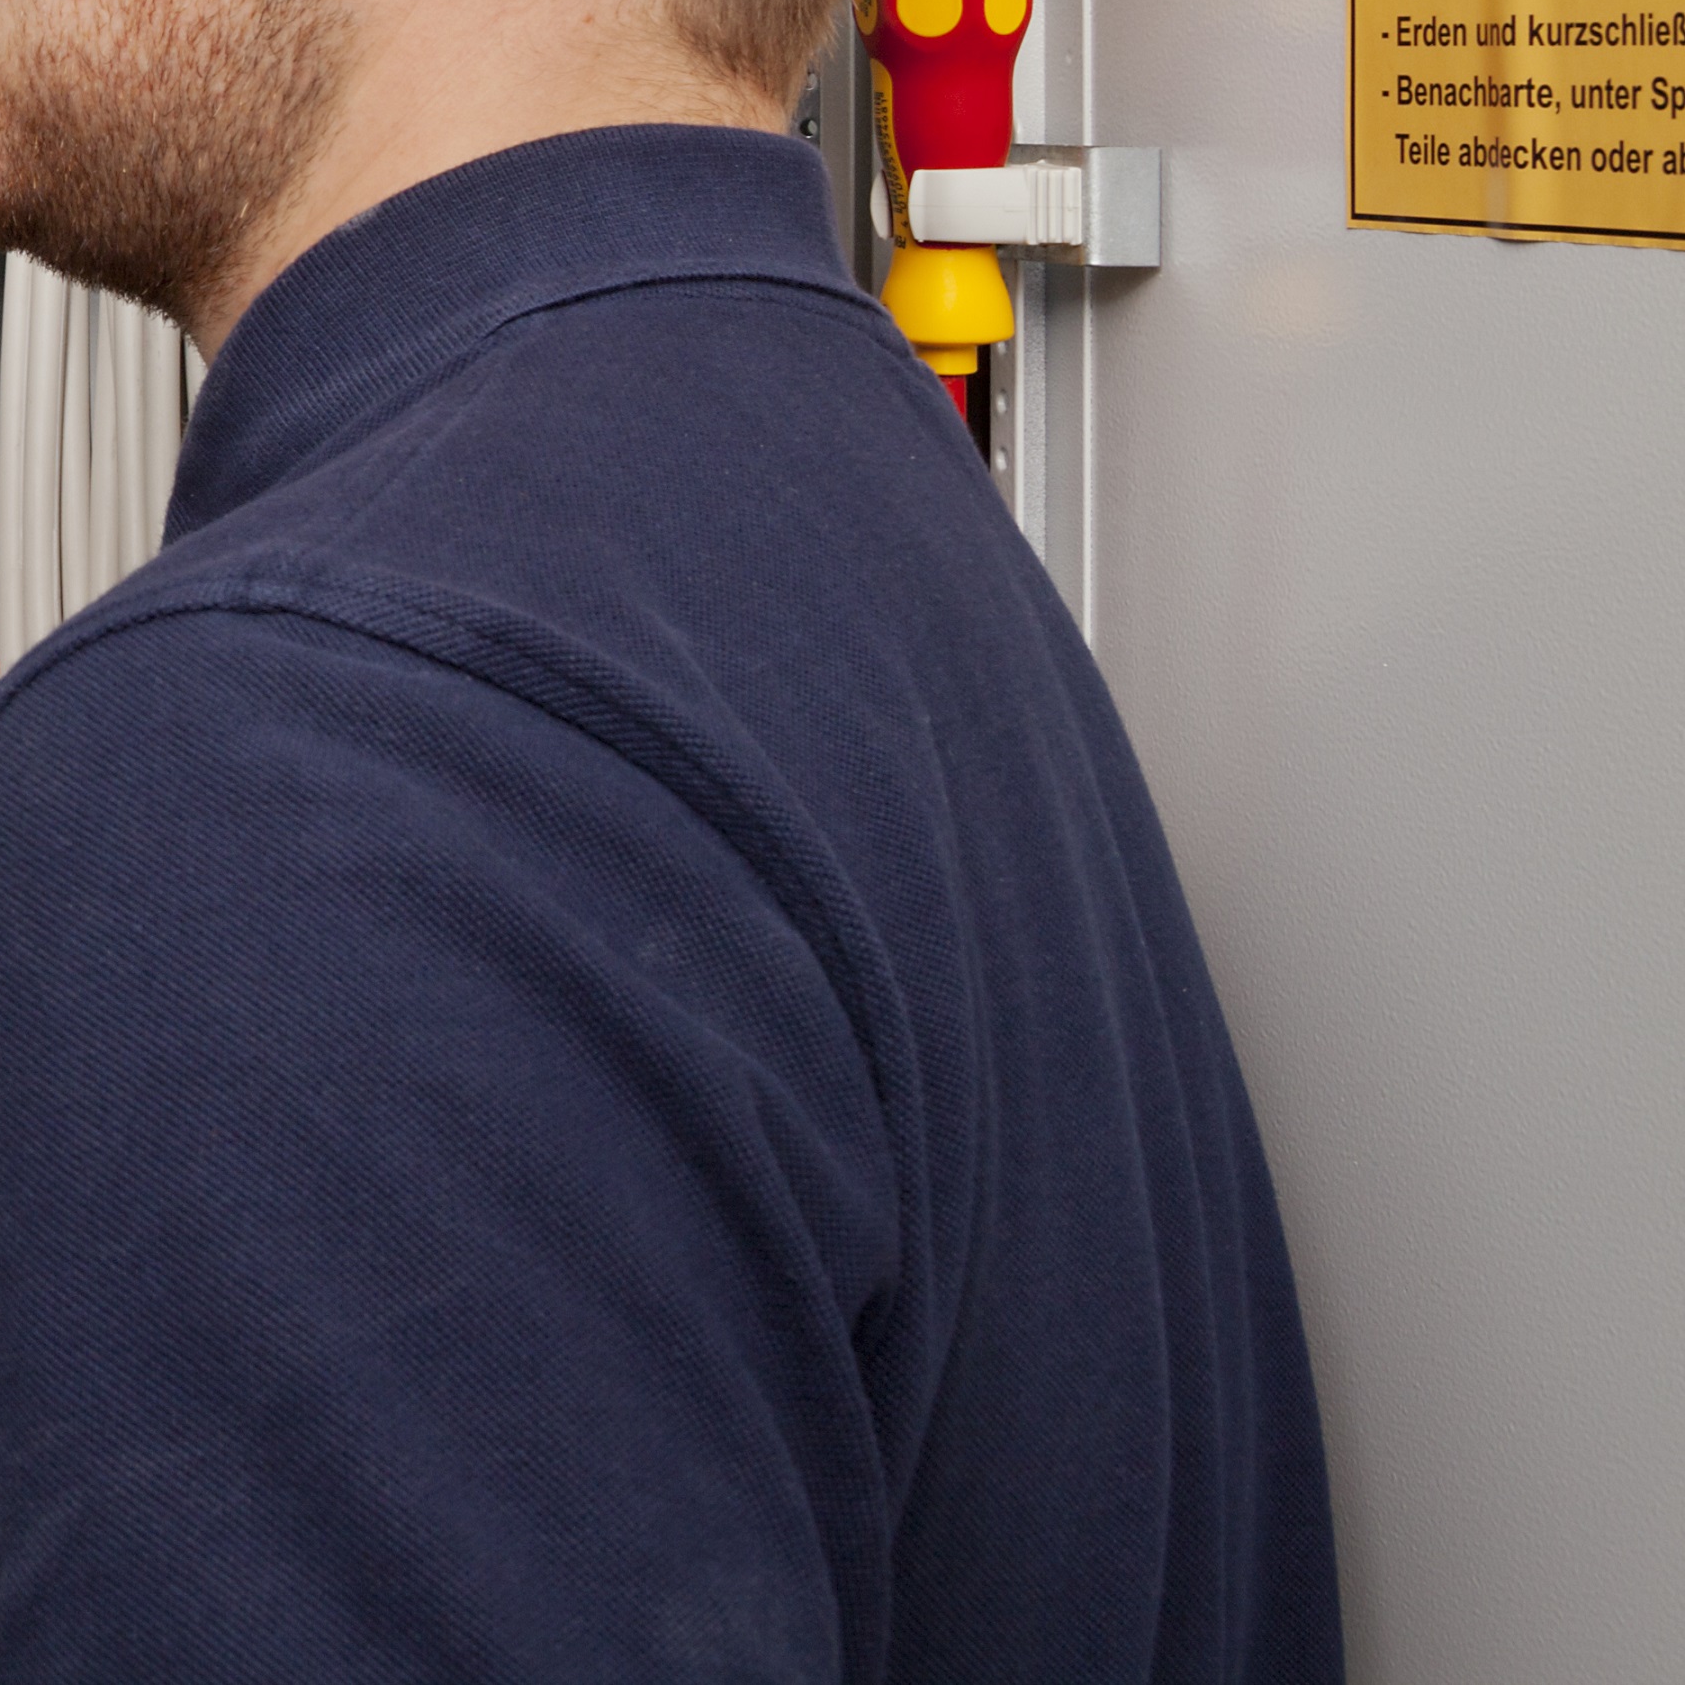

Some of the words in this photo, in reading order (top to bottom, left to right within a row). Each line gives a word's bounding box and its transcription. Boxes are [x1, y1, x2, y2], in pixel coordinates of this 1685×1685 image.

[1396, 16, 1467, 47] Erden
[1477, 14, 1516, 47] und
[1396, 74, 1561, 114] Benachbarte,
[1571, 77, 1641, 110] unter
[1395, 133, 1450, 166] Teile
[1459, 135, 1581, 171] abdecken
[1591, 140, 1653, 174] oder
